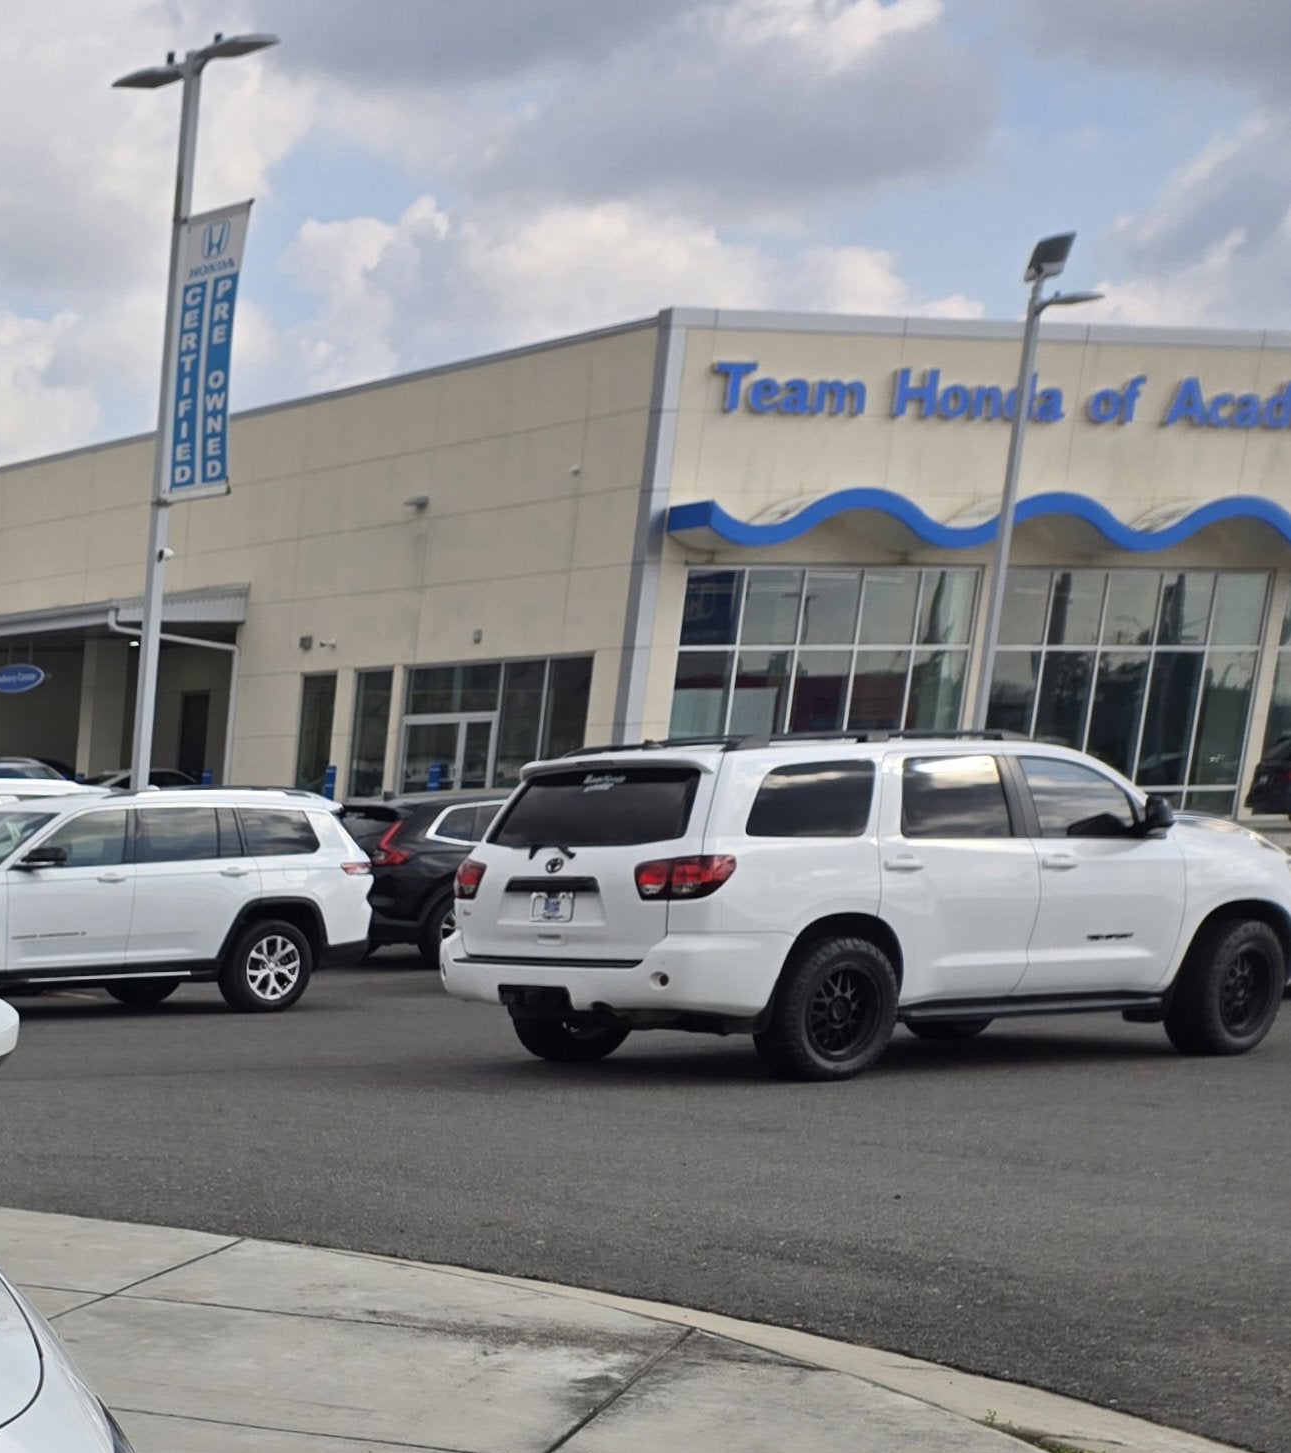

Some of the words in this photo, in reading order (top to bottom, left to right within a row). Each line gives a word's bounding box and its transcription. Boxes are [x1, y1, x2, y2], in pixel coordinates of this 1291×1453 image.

[212, 279, 233, 344] PRE
[174, 286, 203, 485] CERTIFIED
[206, 370, 226, 479] OWNED
[713, 362, 867, 416] Team
[892, 368, 1066, 422] Honda
[1088, 375, 1147, 424] of
